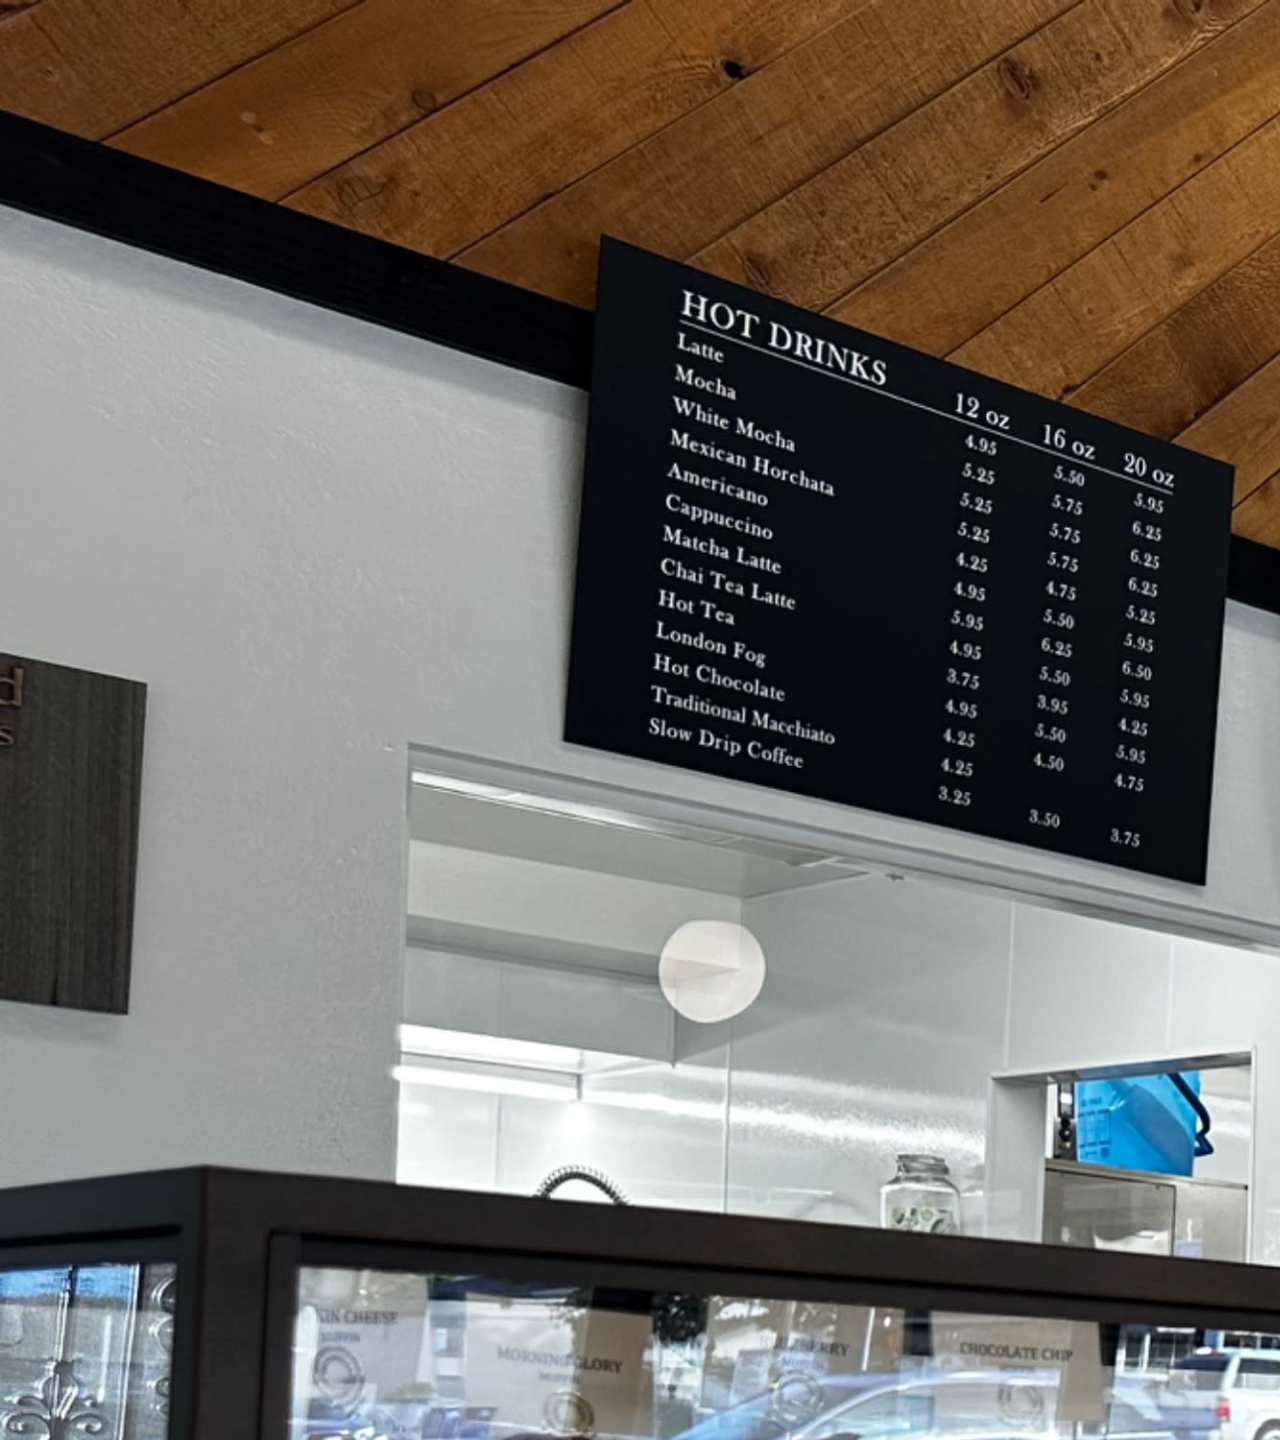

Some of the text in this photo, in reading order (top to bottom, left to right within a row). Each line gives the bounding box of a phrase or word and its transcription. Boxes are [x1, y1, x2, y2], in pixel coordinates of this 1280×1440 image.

[678, 332, 724, 363] Latte
[682, 290, 886, 386] HOT DRINKS
[675, 364, 736, 401] Mocha
[955, 393, 1009, 430] 12 oz
[673, 395, 795, 452] White Mocha
[965, 434, 997, 456] 4.95
[1043, 424, 1095, 460] 16 oz
[671, 428, 834, 496] Mexican Horchata
[1124, 452, 1175, 488] 20 oz
[667, 462, 769, 506] Americano
[962, 462, 995, 485] 5.25
[1053, 465, 1085, 487] 5.50
[960, 492, 992, 514] 5.25
[1051, 494, 1083, 516] 5.75
[1134, 492, 1164, 514] 5.95
[665, 493, 773, 540] Cappuccino
[957, 521, 990, 544] 5.25
[1049, 522, 1081, 544] 5.75
[1132, 521, 1162, 542] 6.25
[663, 524, 782, 574] Matcha Latte
[1130, 549, 1160, 570] 6.25
[956, 552, 988, 573] 4.25
[1047, 551, 1079, 573] 5.75
[660, 557, 796, 610] Chai Tea Latte
[954, 581, 986, 602] 4.95
[1046, 581, 1076, 601] 4.75
[1128, 577, 1158, 598] 6.25
[658, 589, 735, 625] Hot Tea
[1126, 604, 1156, 625] 5.25
[951, 609, 984, 631] 5.95
[1043, 608, 1075, 630] 5.50
[656, 621, 766, 669] London Fog
[950, 640, 982, 660] 4.95
[1041, 637, 1072, 658] 6.25
[1123, 633, 1154, 653] 5.95
[653, 653, 785, 702] Hot Chocolate
[946, 668, 980, 690] 3.75
[1039, 665, 1071, 687] 5.50
[1122, 660, 1153, 681] 6.50
[945, 699, 978, 719] 4.95
[1037, 694, 1068, 715] 3.95
[1119, 688, 1150, 709] 5.95
[651, 685, 836, 745] Traditional Macchiato
[943, 728, 975, 748] 4.25
[1035, 723, 1066, 743] 5.50
[1119, 717, 1148, 737] 4.25
[648, 717, 804, 769] Slow Drip Coffee
[1034, 752, 1065, 772] 4.50
[1115, 744, 1146, 765] 5.95
[941, 757, 973, 777] 4.25
[1114, 773, 1144, 792] 4.75
[938, 785, 971, 806] 3.25
[1029, 808, 1061, 829] 3.50
[1110, 828, 1140, 848] 3.75
[497, 1346, 624, 1374] MORNING GLORY
[960, 1341, 1074, 1362] CHOCOLATE CHIP
